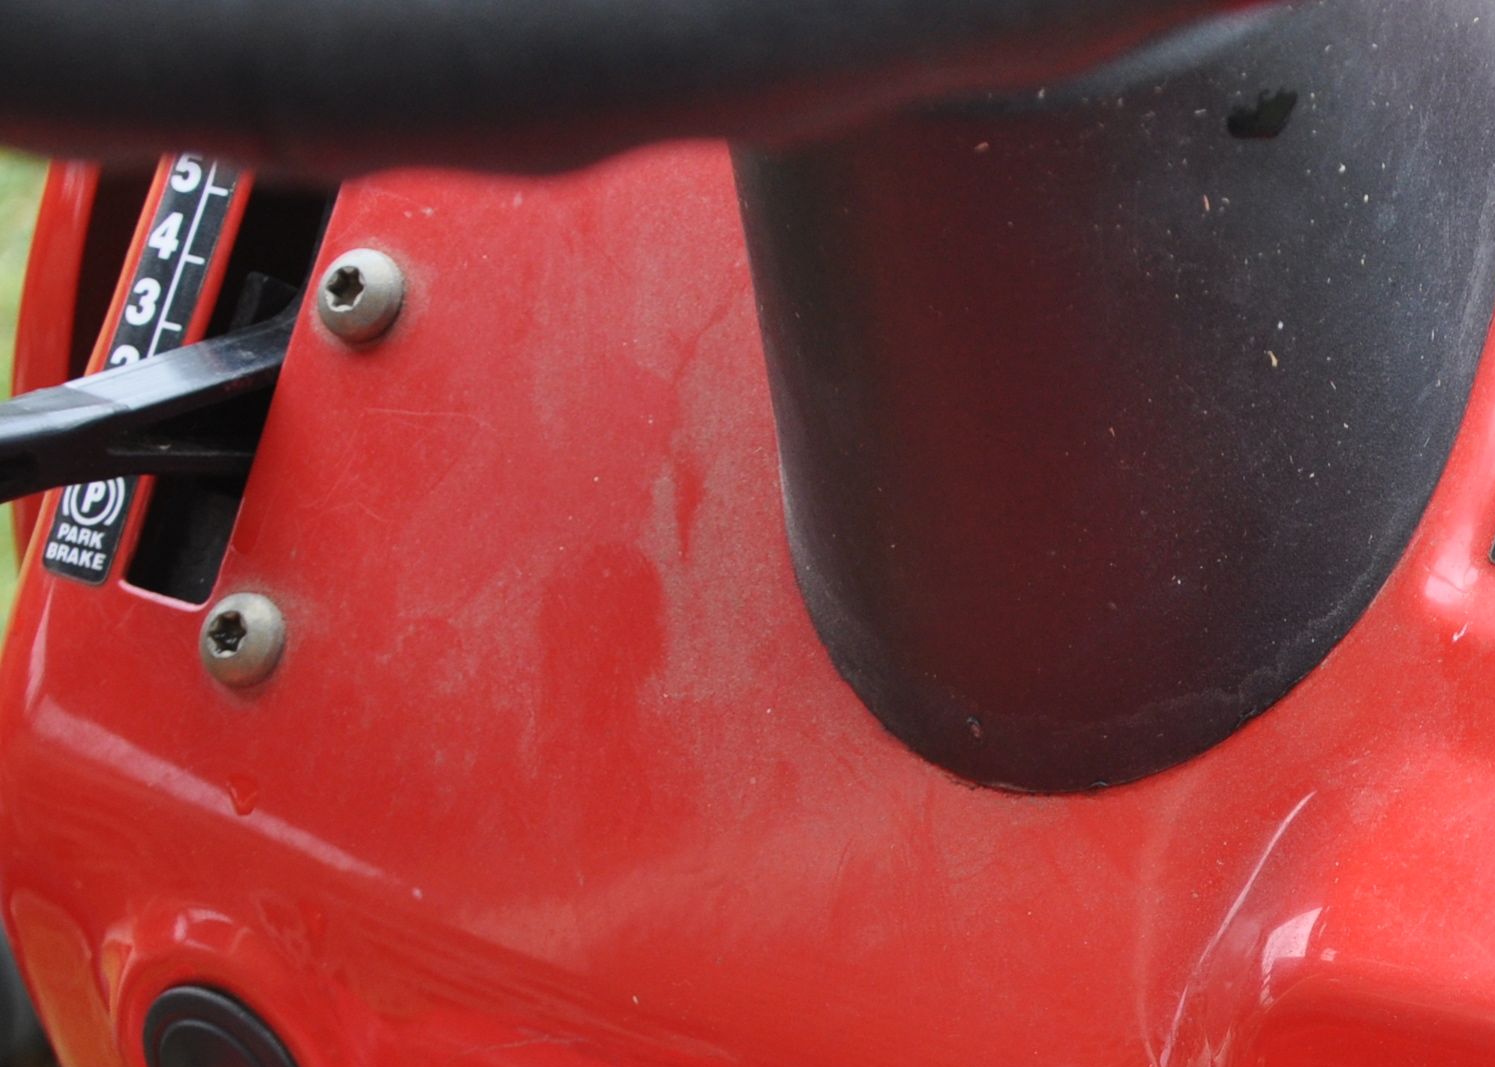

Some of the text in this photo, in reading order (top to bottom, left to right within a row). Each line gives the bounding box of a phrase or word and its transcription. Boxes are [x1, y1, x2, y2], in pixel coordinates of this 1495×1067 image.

[170, 153, 202, 193] 5
[148, 212, 184, 260] 4
[125, 277, 161, 326] 3
[45, 541, 107, 571] BRAKE
[57, 522, 105, 550] PARK
